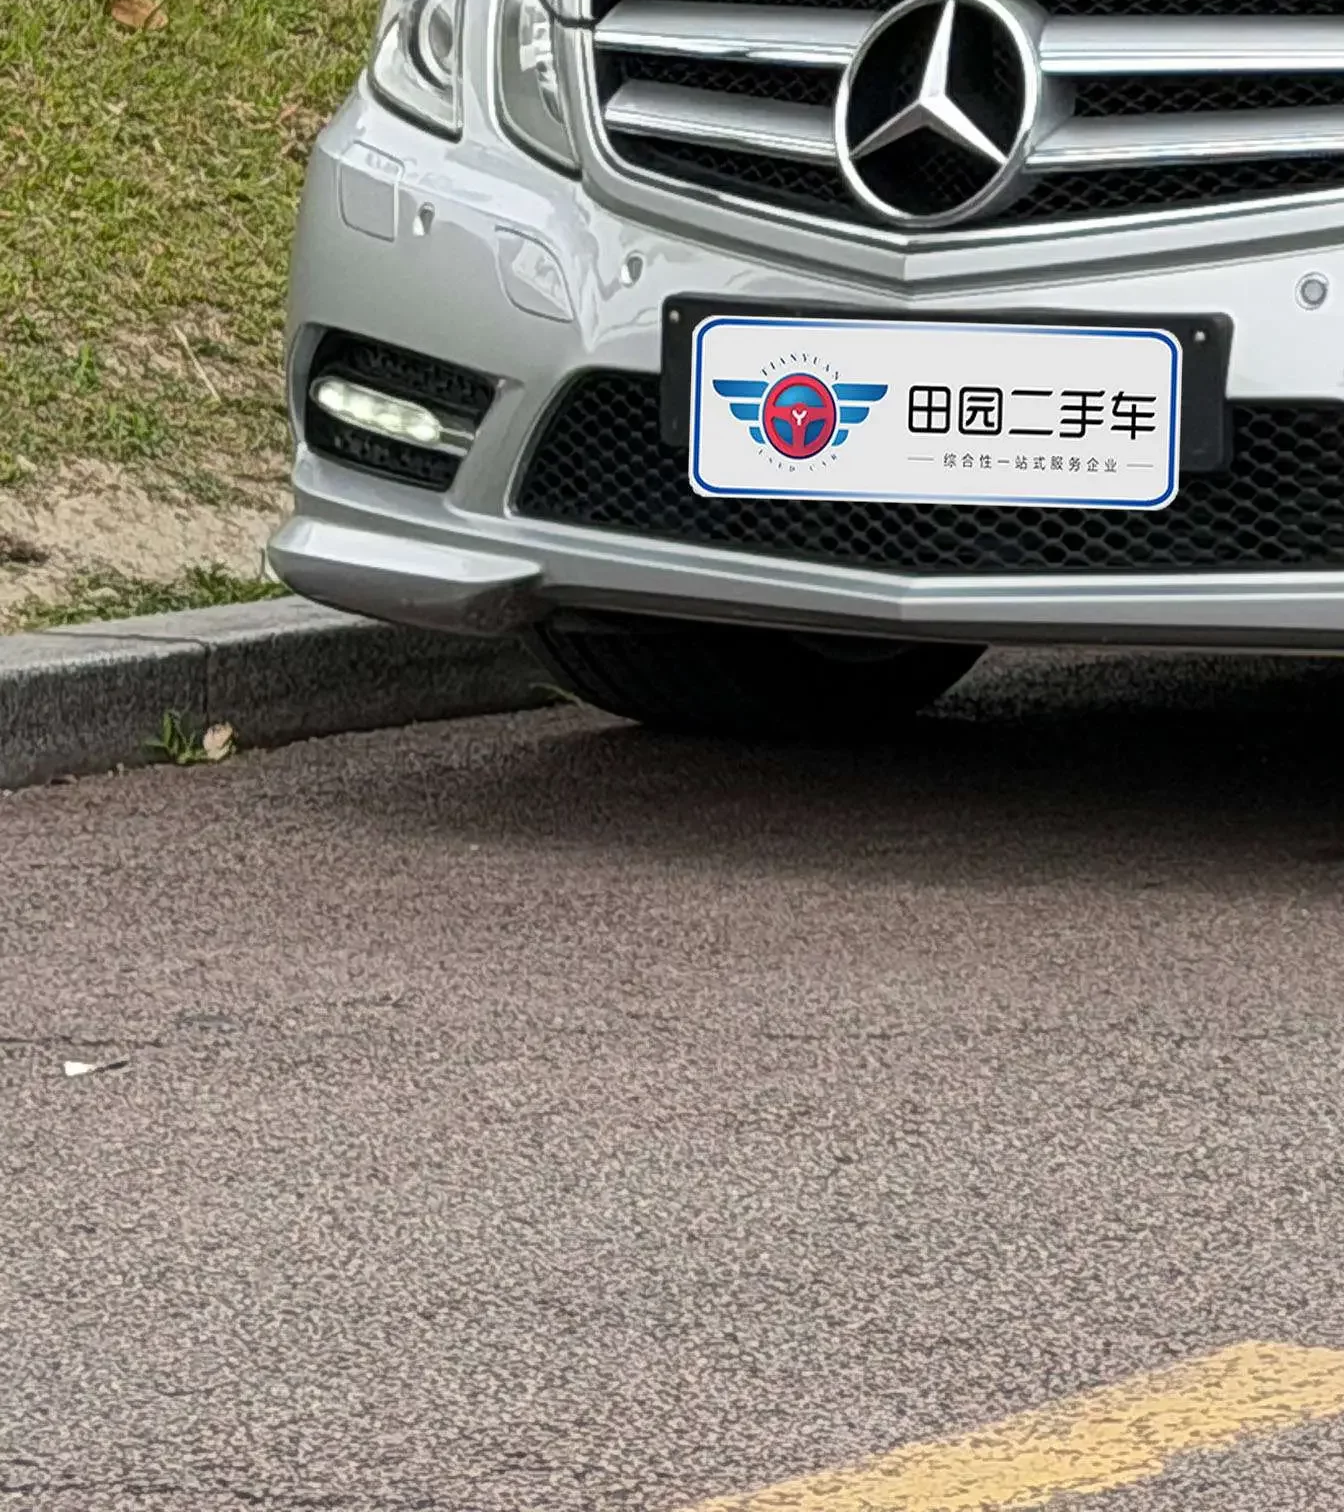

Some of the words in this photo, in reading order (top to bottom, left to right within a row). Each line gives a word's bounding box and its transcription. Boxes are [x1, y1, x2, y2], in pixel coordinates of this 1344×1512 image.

[907, 384, 1158, 441] 田园二手车
[942, 452, 1118, 474] 综合性一站式服务企业
